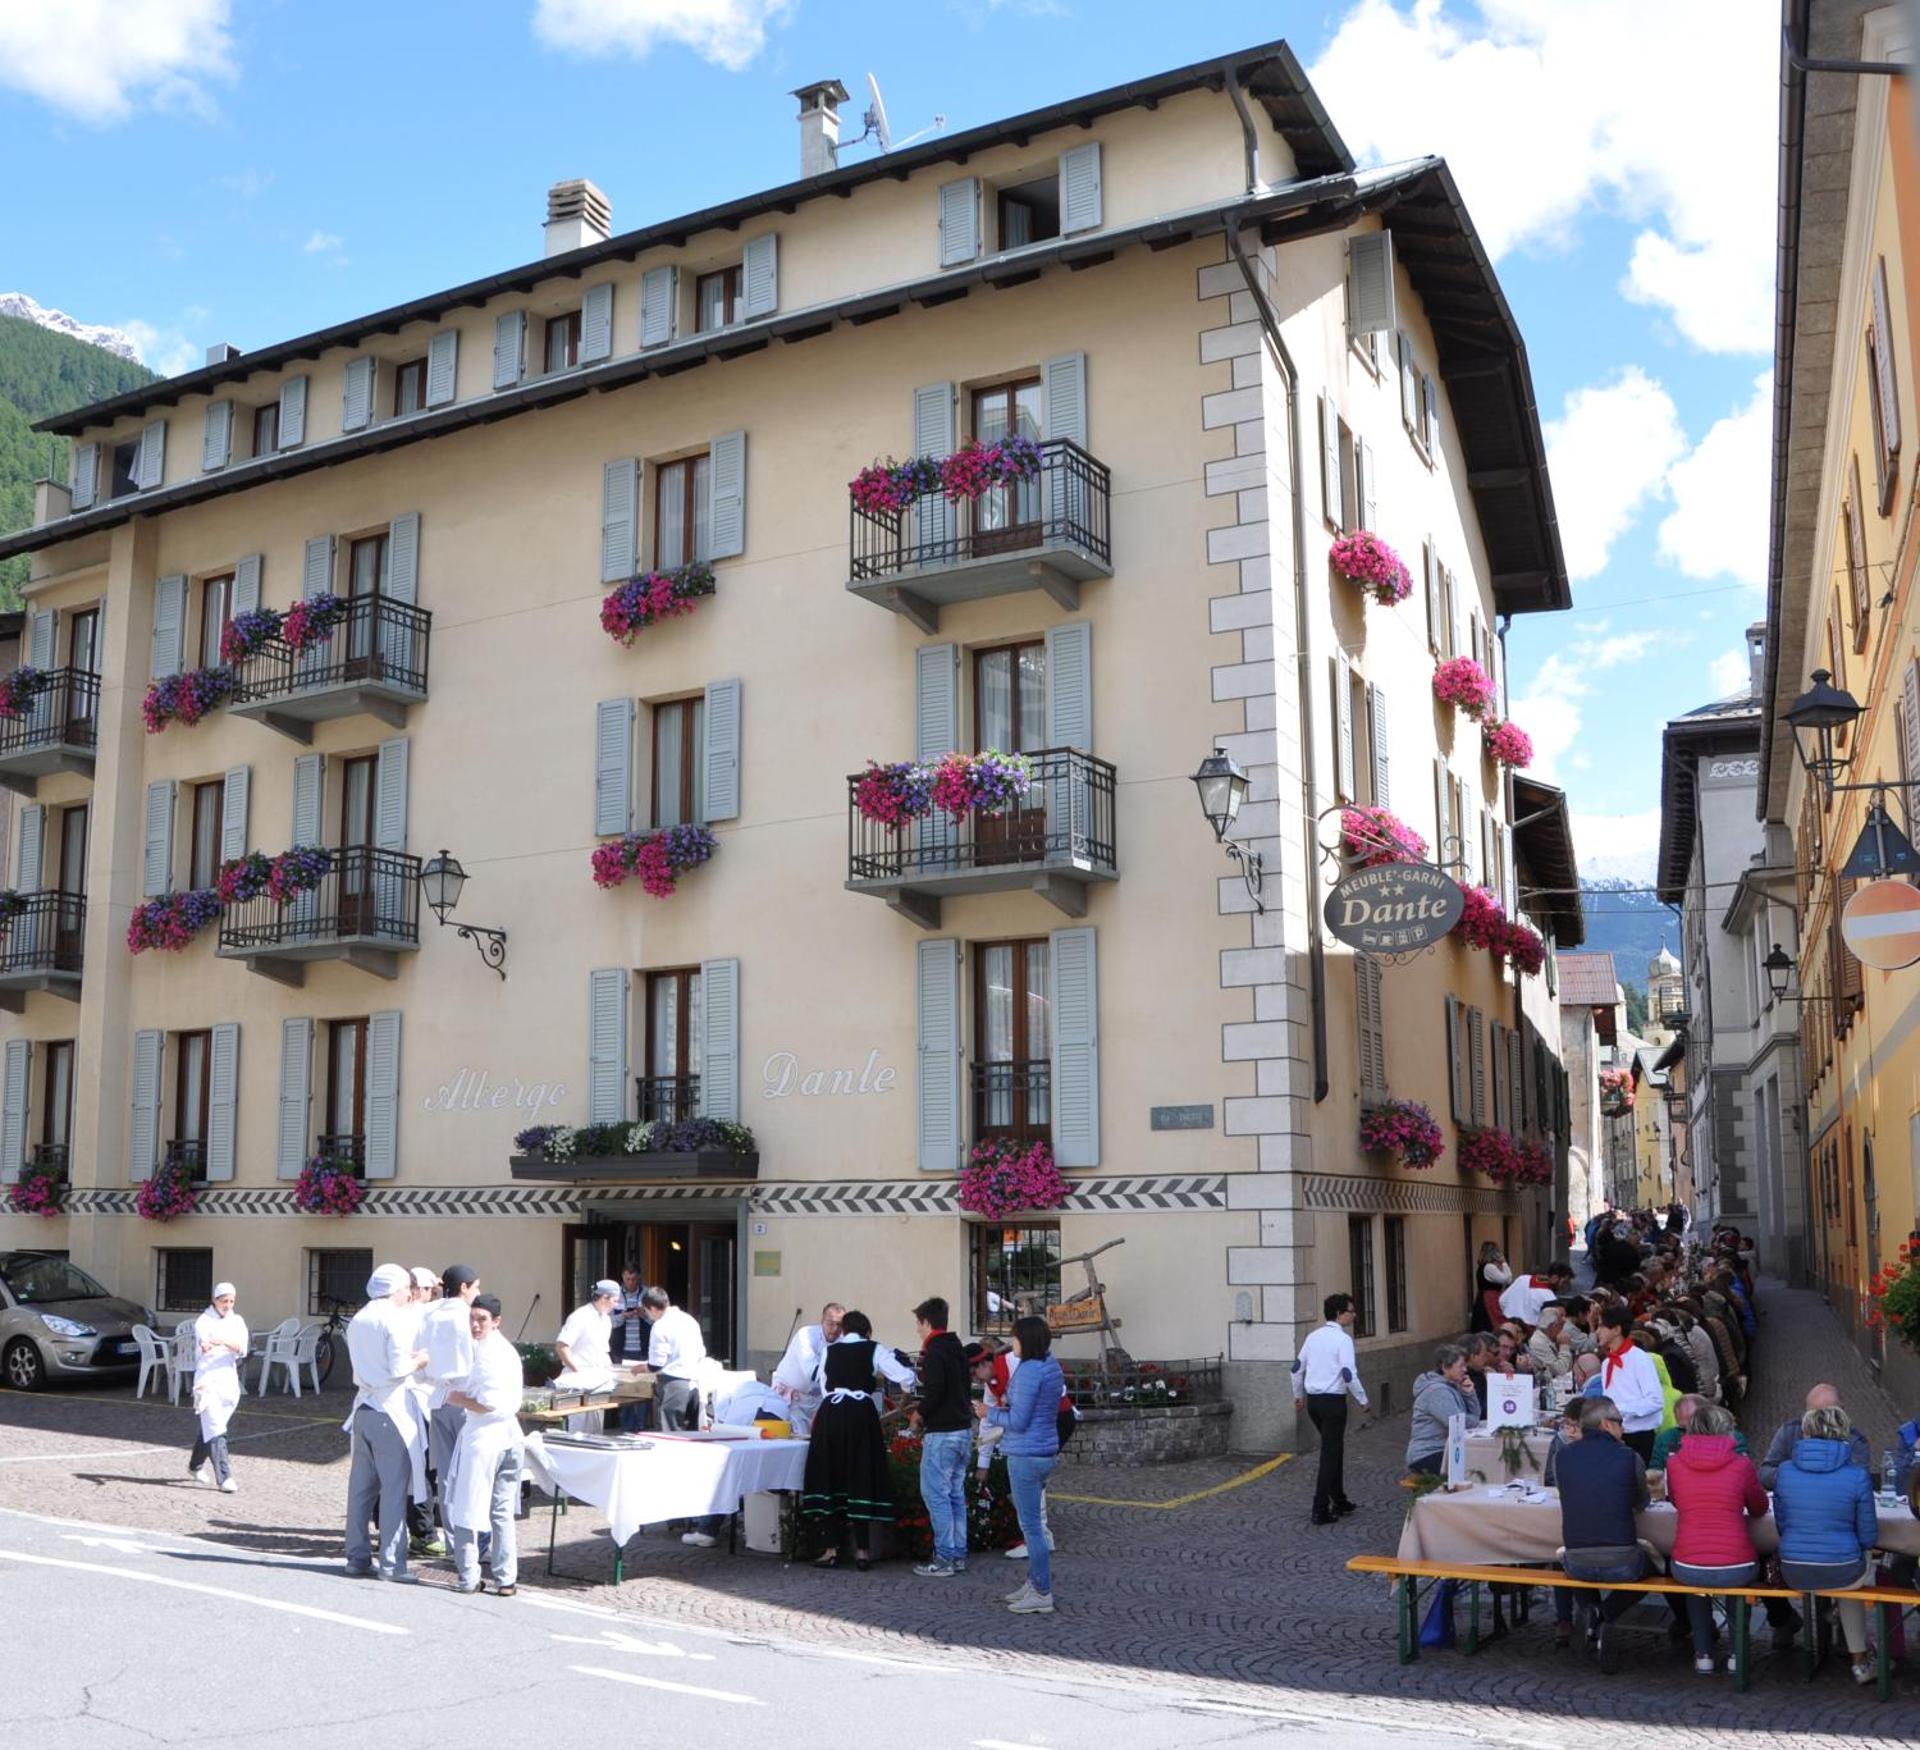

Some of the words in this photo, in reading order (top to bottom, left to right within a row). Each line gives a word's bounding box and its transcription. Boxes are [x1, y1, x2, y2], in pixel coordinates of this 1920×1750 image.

[1402, 870, 1445, 889] GARNI
[1339, 894, 1448, 927] Dante
[763, 1048, 896, 1099] Dante
